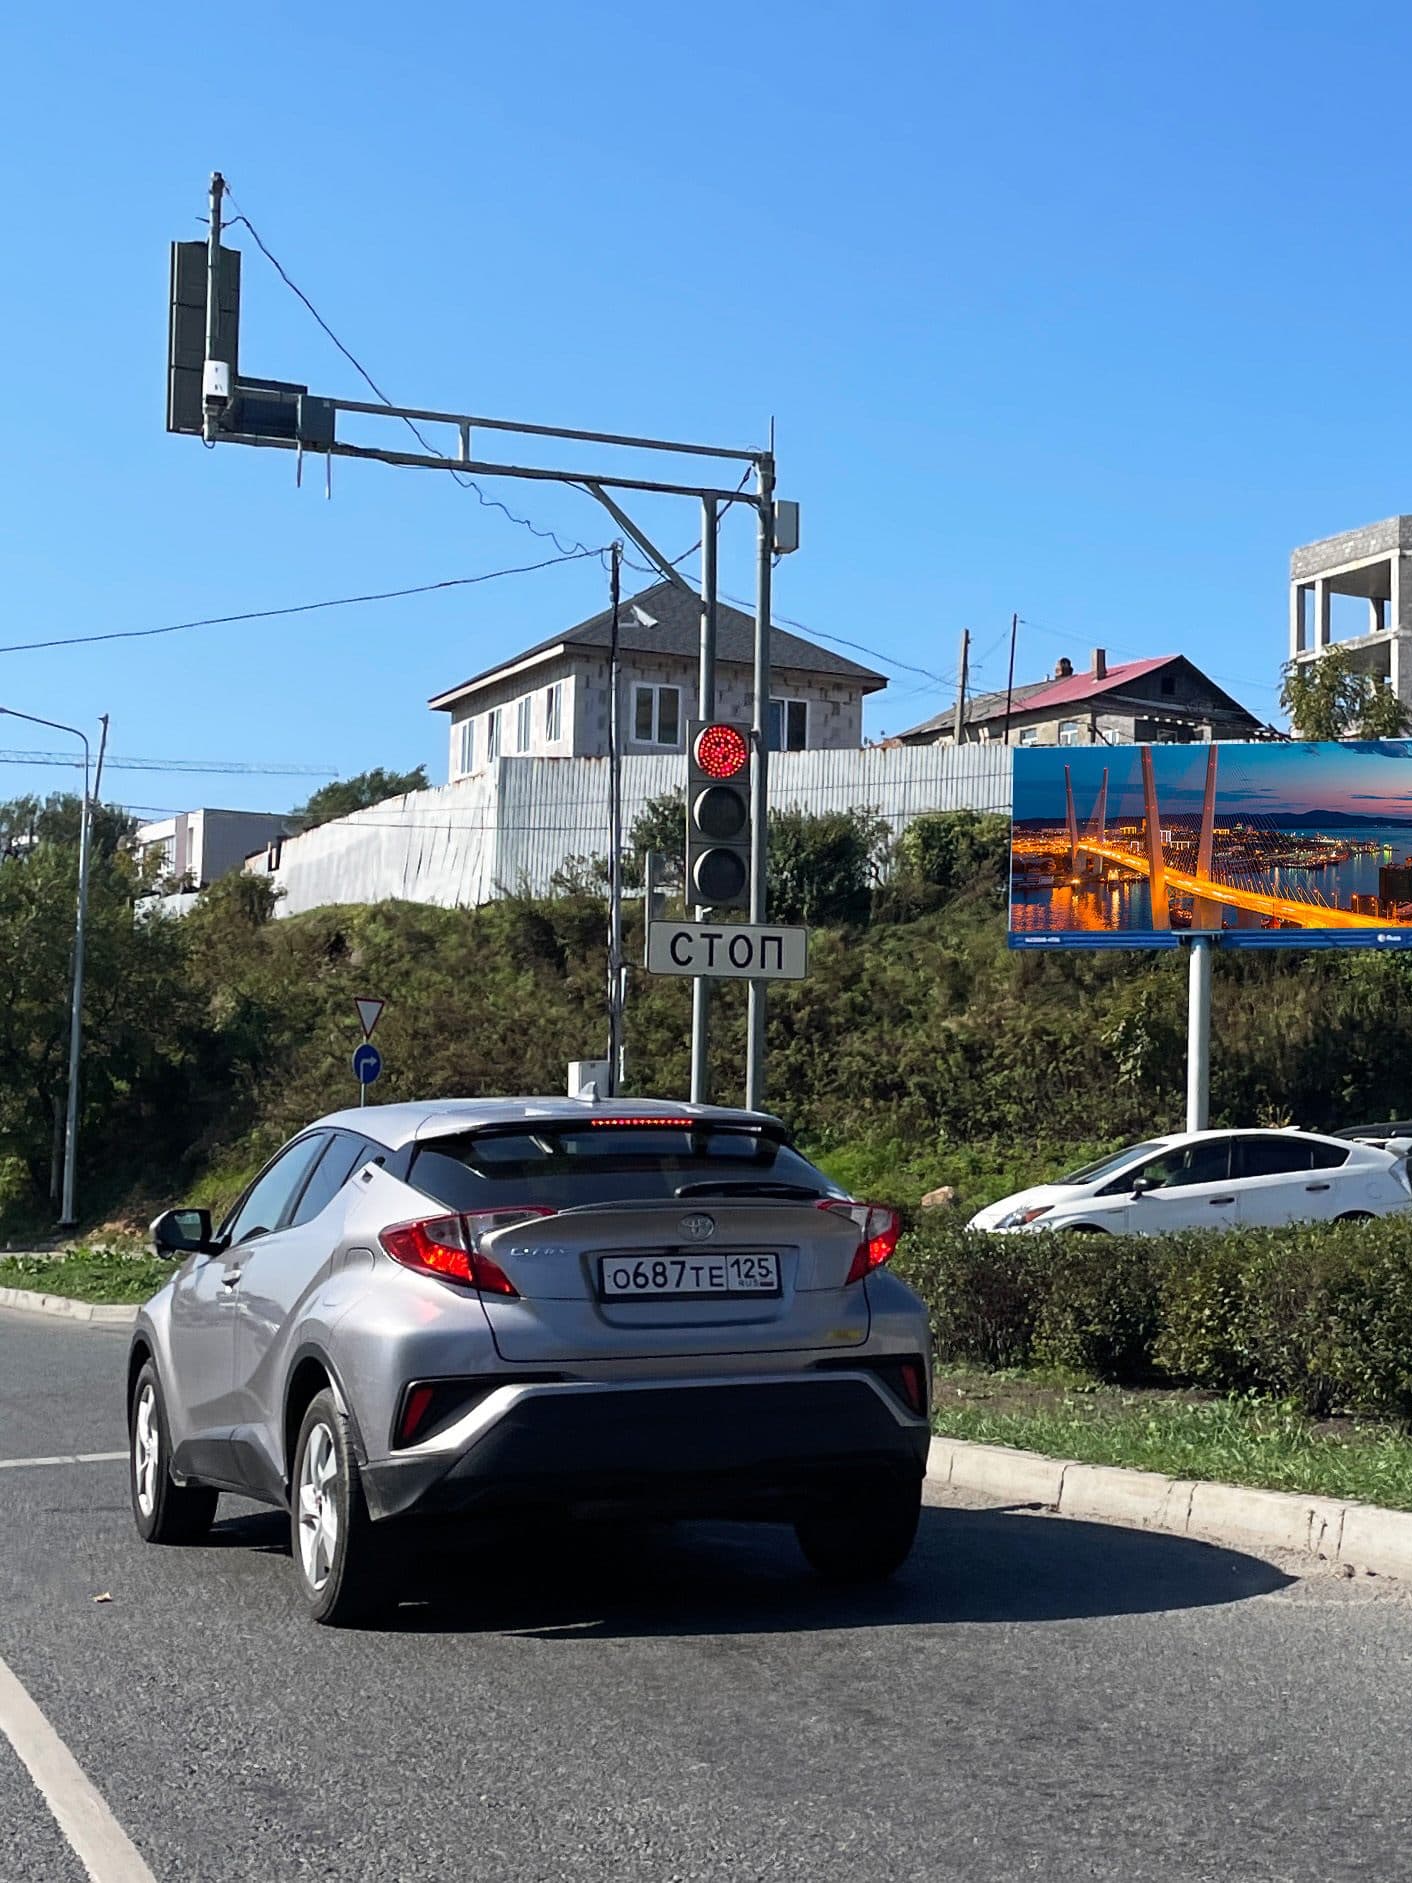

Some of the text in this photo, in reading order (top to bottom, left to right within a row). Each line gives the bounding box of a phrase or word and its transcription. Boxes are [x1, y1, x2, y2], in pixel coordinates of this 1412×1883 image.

[670, 931, 783, 970] СТОП
[613, 1258, 770, 1289] О687ТЕ 125
[738, 1279, 759, 1288] RUS
